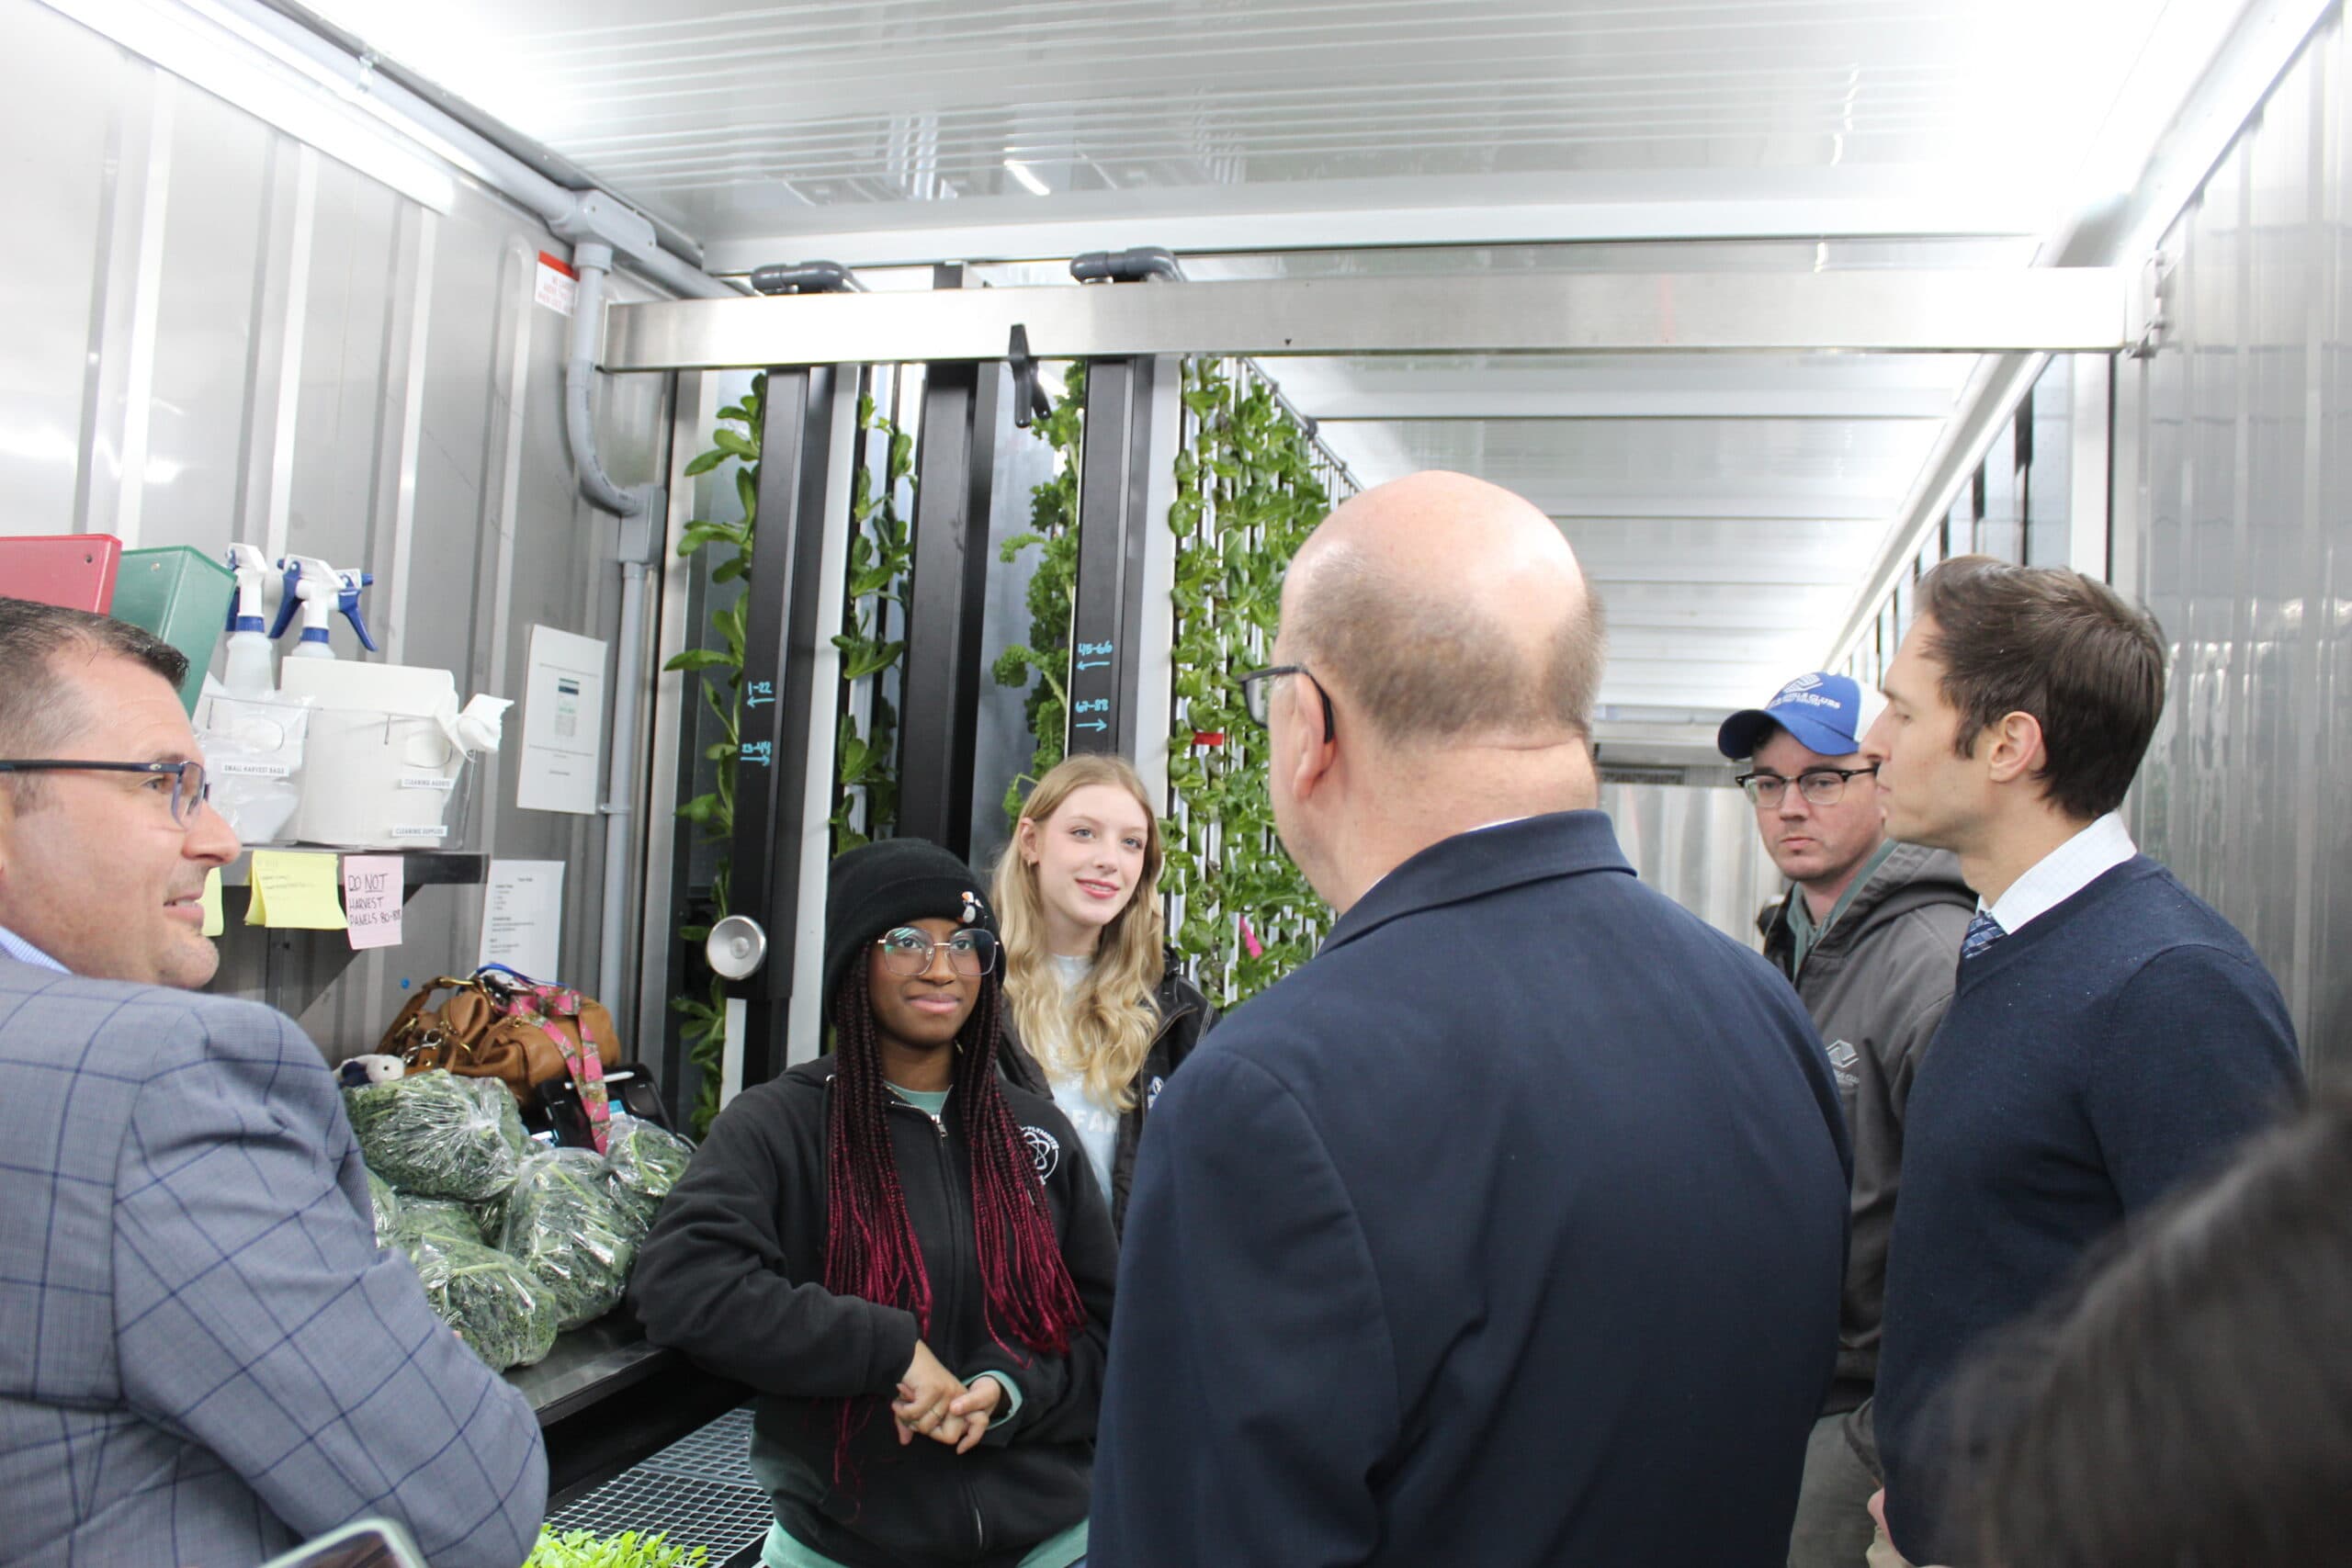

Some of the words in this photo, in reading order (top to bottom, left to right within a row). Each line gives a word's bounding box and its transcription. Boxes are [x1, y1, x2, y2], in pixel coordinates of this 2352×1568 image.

[1078, 640, 1113, 656] 45-66
[748, 681, 773, 695] 1-22
[1075, 699, 1109, 713] 67-88
[224, 763, 242, 772] SMALL
[243, 765, 267, 773] HARVEST
[269, 766, 284, 774] BAGS
[404, 778, 430, 786] CLEANING
[348, 874, 361, 891] DO
[365, 873, 389, 890] NOT
[349, 897, 384, 909] HARVEST
[349, 912, 378, 926] PANELS
